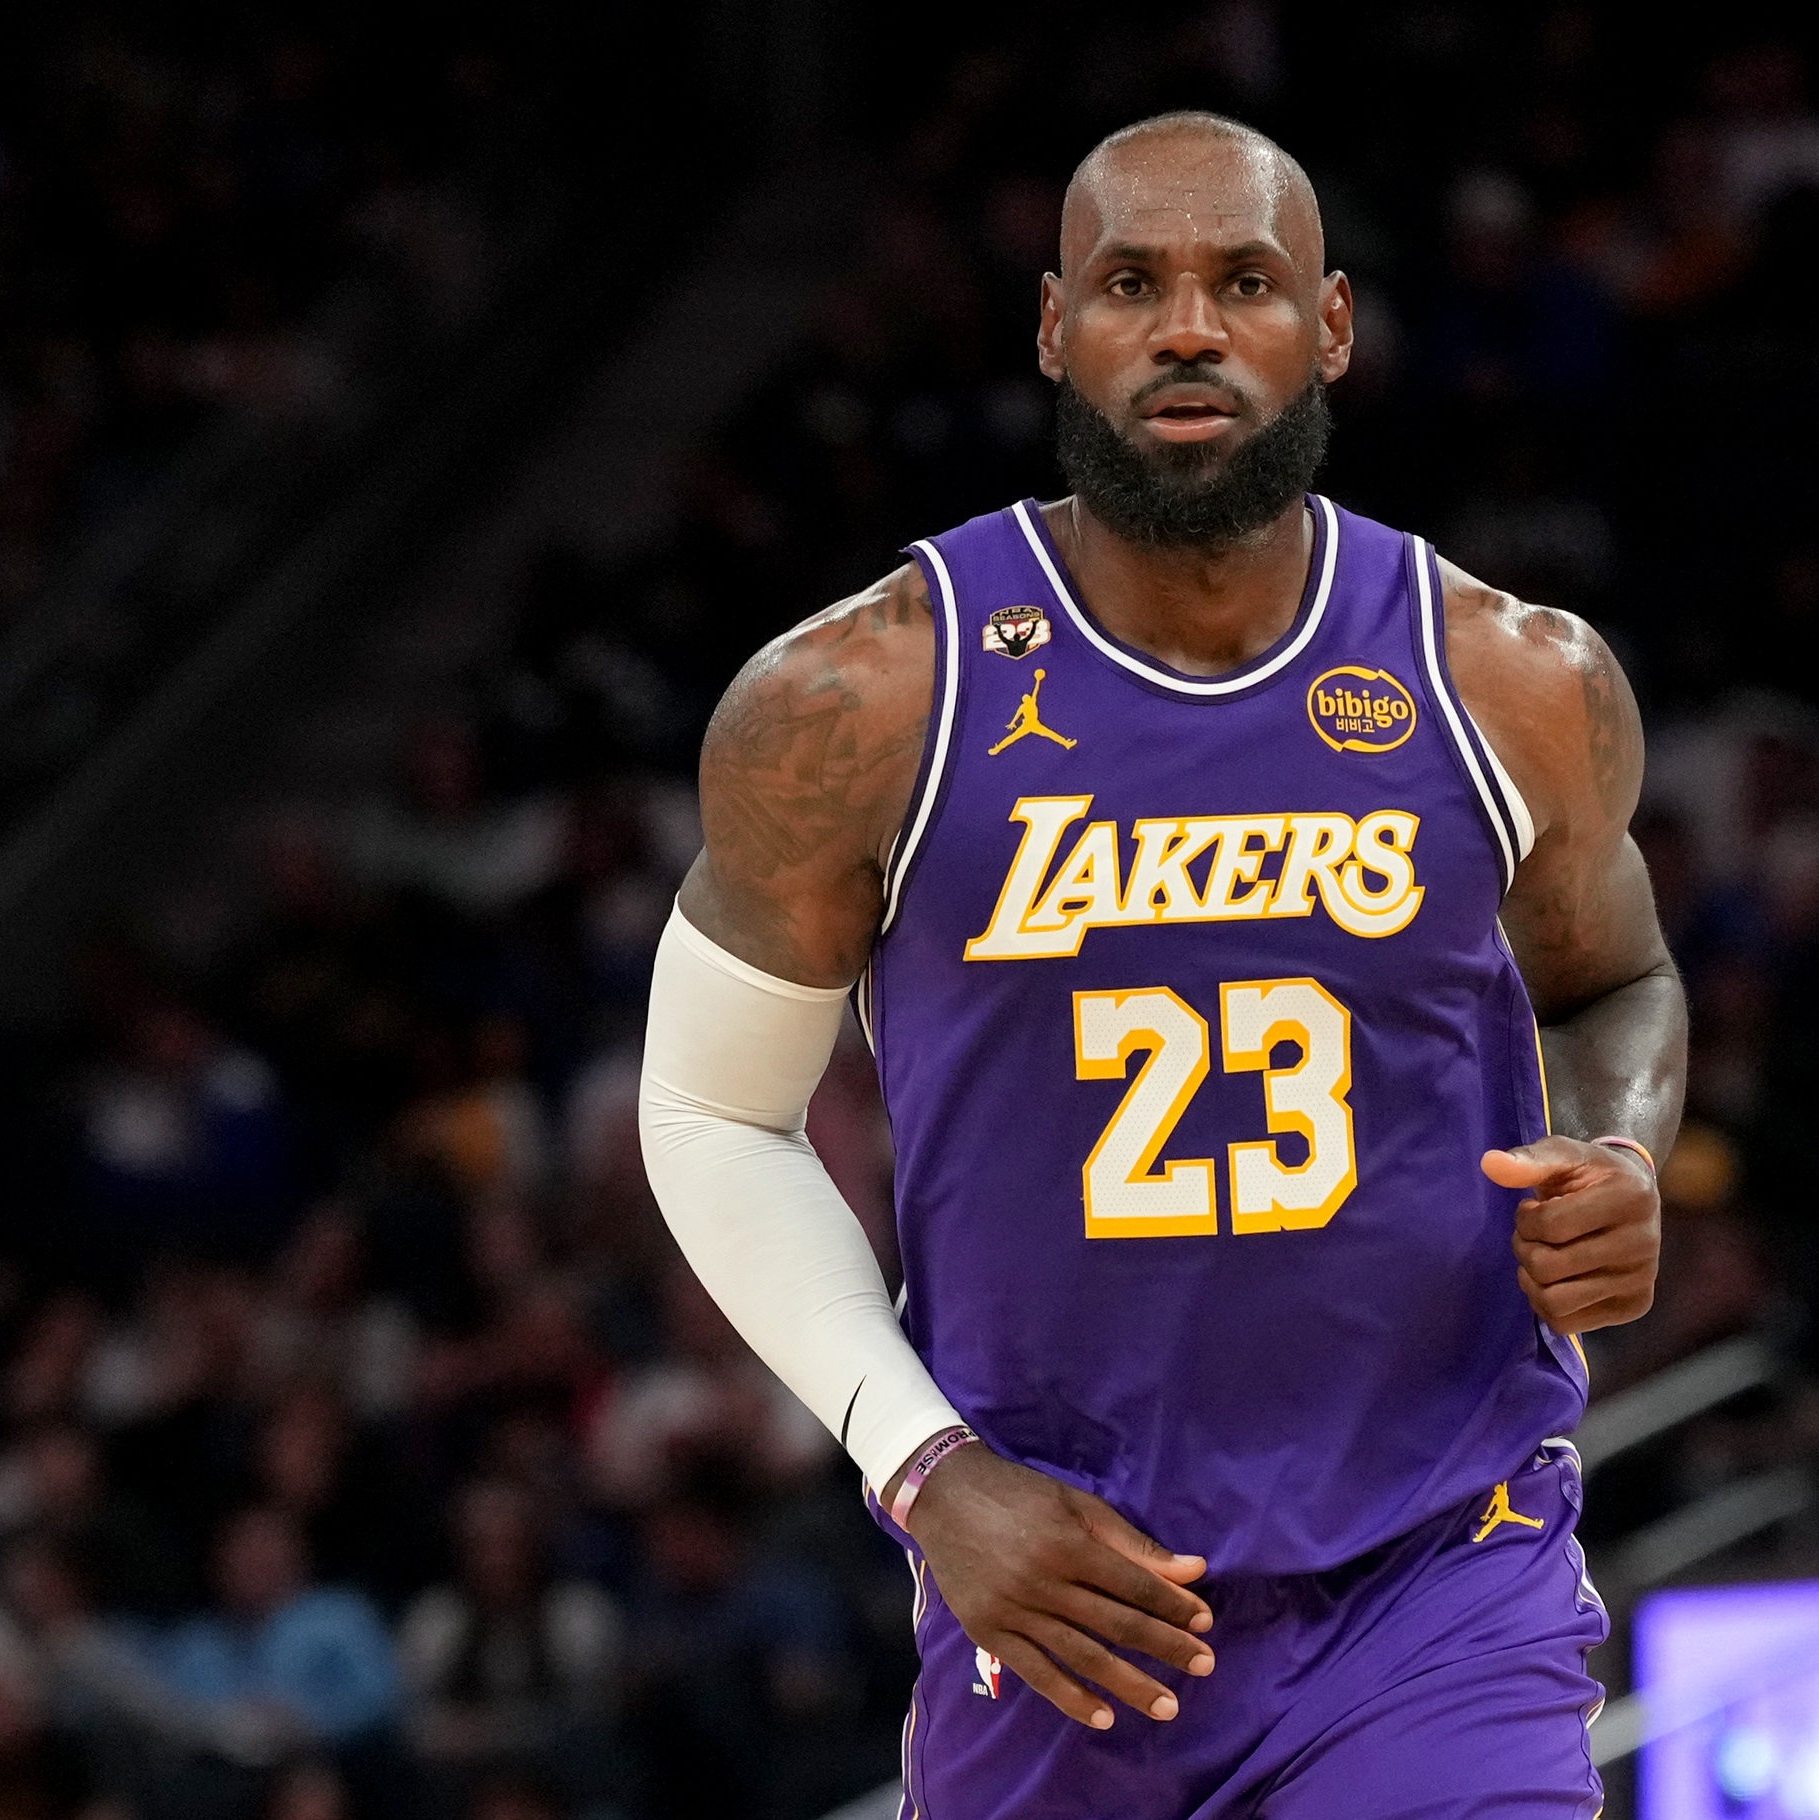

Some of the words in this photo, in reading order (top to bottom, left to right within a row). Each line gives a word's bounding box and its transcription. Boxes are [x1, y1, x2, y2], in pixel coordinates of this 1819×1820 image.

[1316, 688, 1409, 728] bibigo
[1335, 718, 1375, 733] 비비고
[962, 793, 1425, 962] LAKERS
[1072, 976, 1358, 1240] 23
[972, 1682, 989, 1697] NBA
